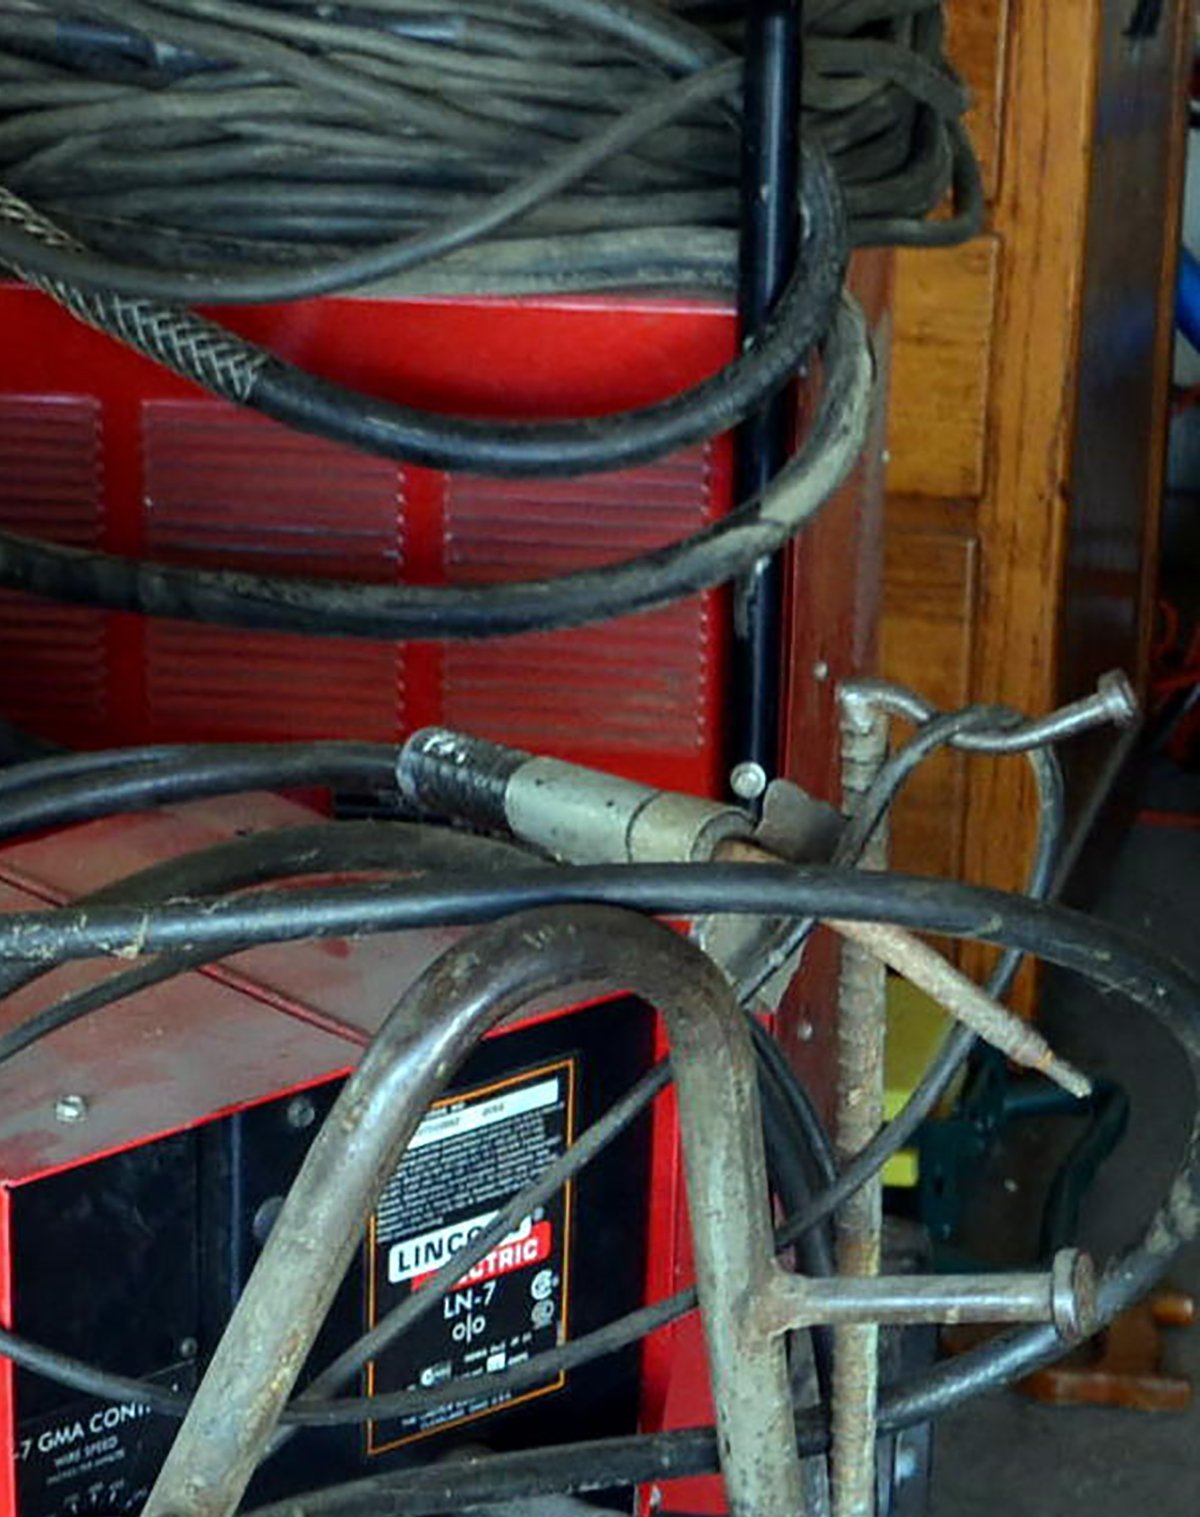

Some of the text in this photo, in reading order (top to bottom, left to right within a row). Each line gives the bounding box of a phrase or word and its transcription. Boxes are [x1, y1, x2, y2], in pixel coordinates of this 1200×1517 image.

[398, 1225, 486, 1273] LINC
[457, 1238, 539, 1285] CTRIC
[443, 1280, 497, 1320] LN-7
[37, 1421, 85, 1453] GMA
[88, 1400, 151, 1434] CON
